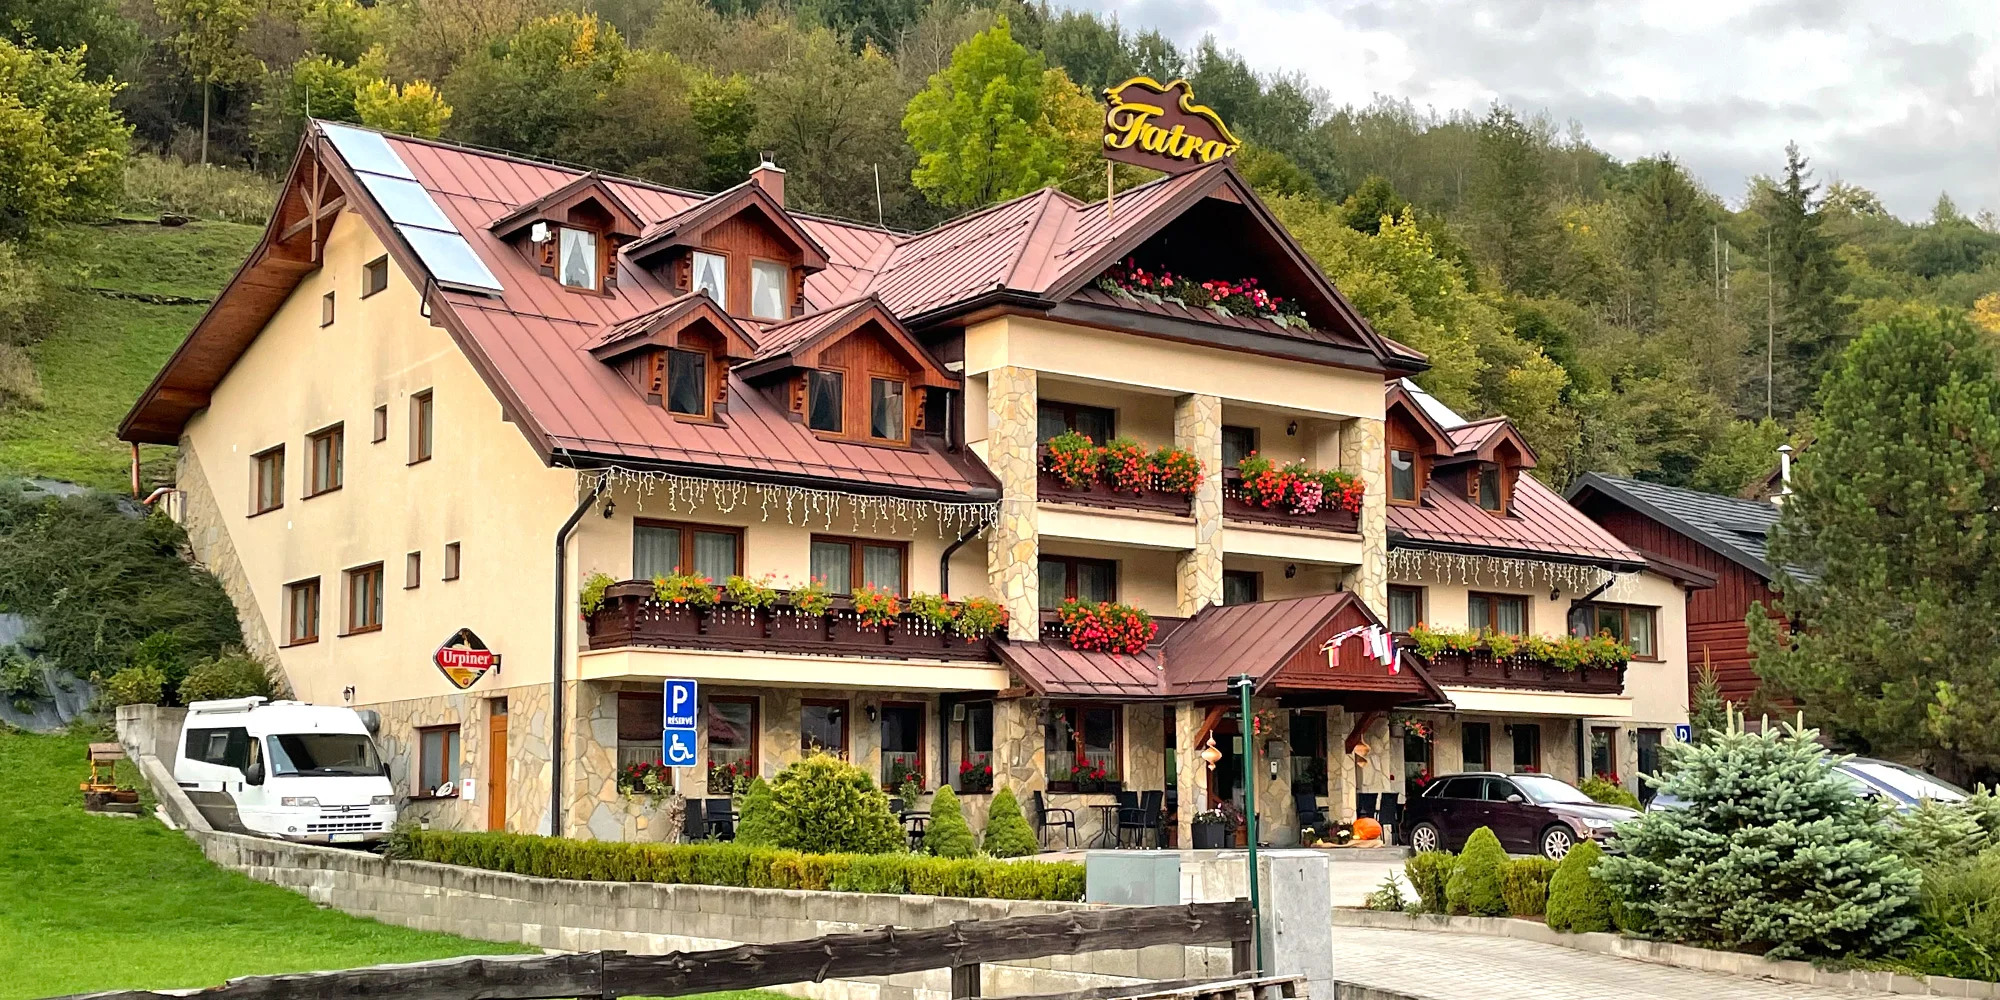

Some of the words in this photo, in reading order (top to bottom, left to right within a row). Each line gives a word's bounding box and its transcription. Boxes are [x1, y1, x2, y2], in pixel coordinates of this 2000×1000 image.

[1104, 103, 1230, 163] Tatra
[443, 650, 490, 667] Urpiner
[672, 685, 688, 714] P
[667, 715, 693, 726] RÉSERVÉ
